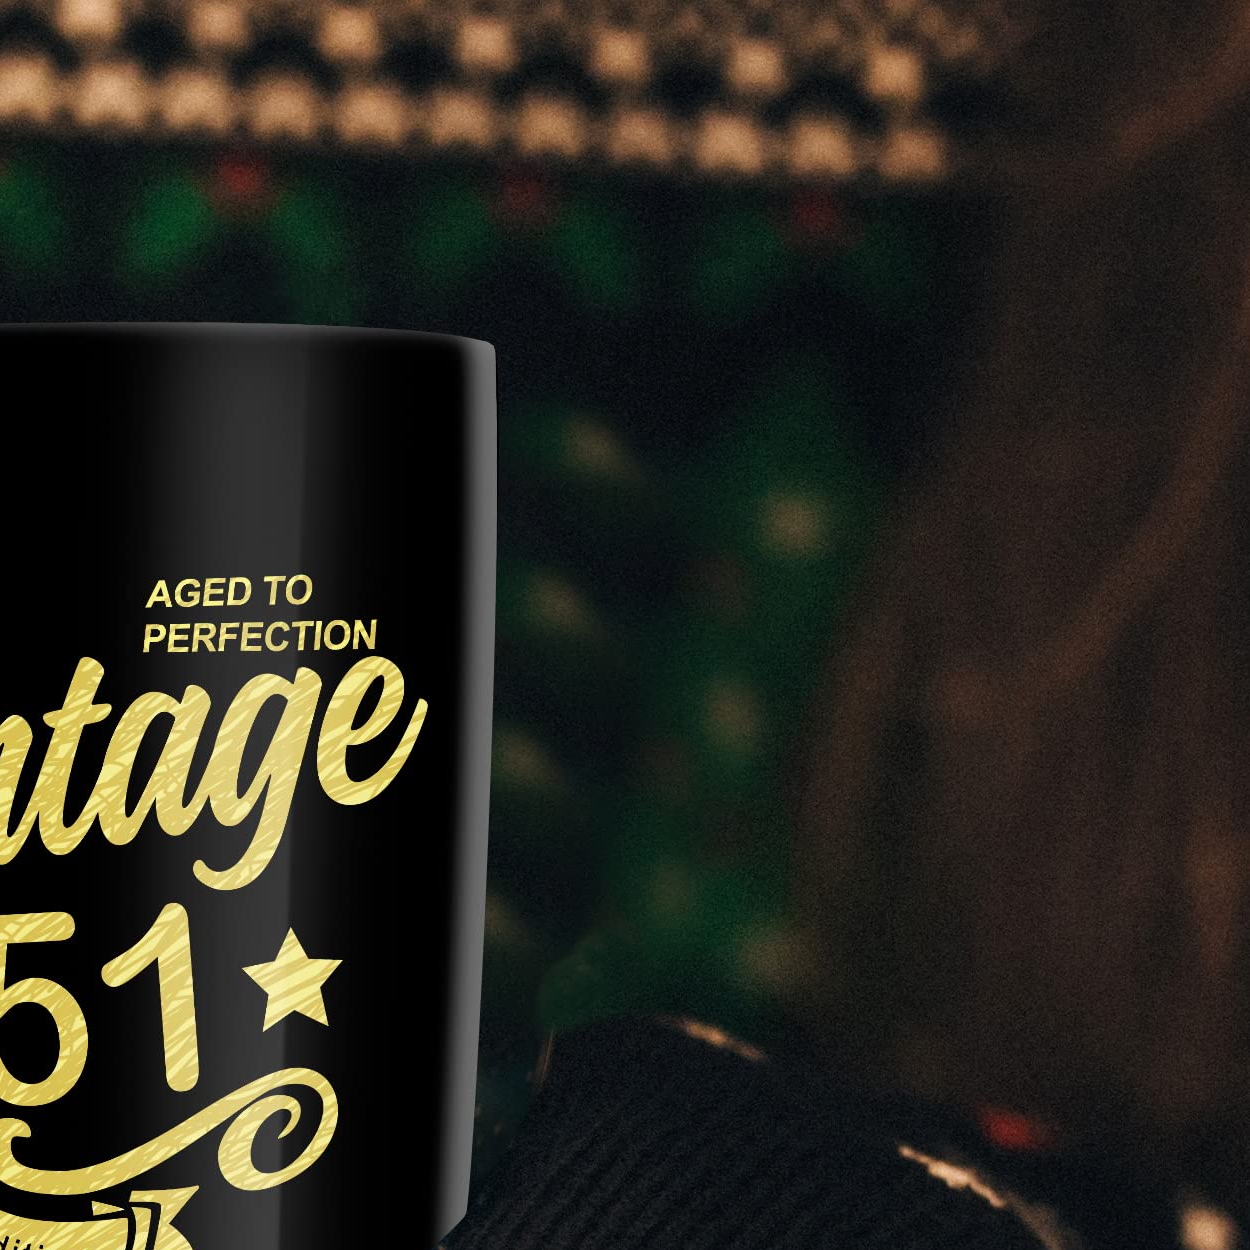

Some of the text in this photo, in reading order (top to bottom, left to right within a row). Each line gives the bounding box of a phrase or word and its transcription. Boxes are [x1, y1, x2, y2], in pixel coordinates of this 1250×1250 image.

[145, 574, 313, 609] AGED TO
[142, 619, 378, 653] PERFECTION
